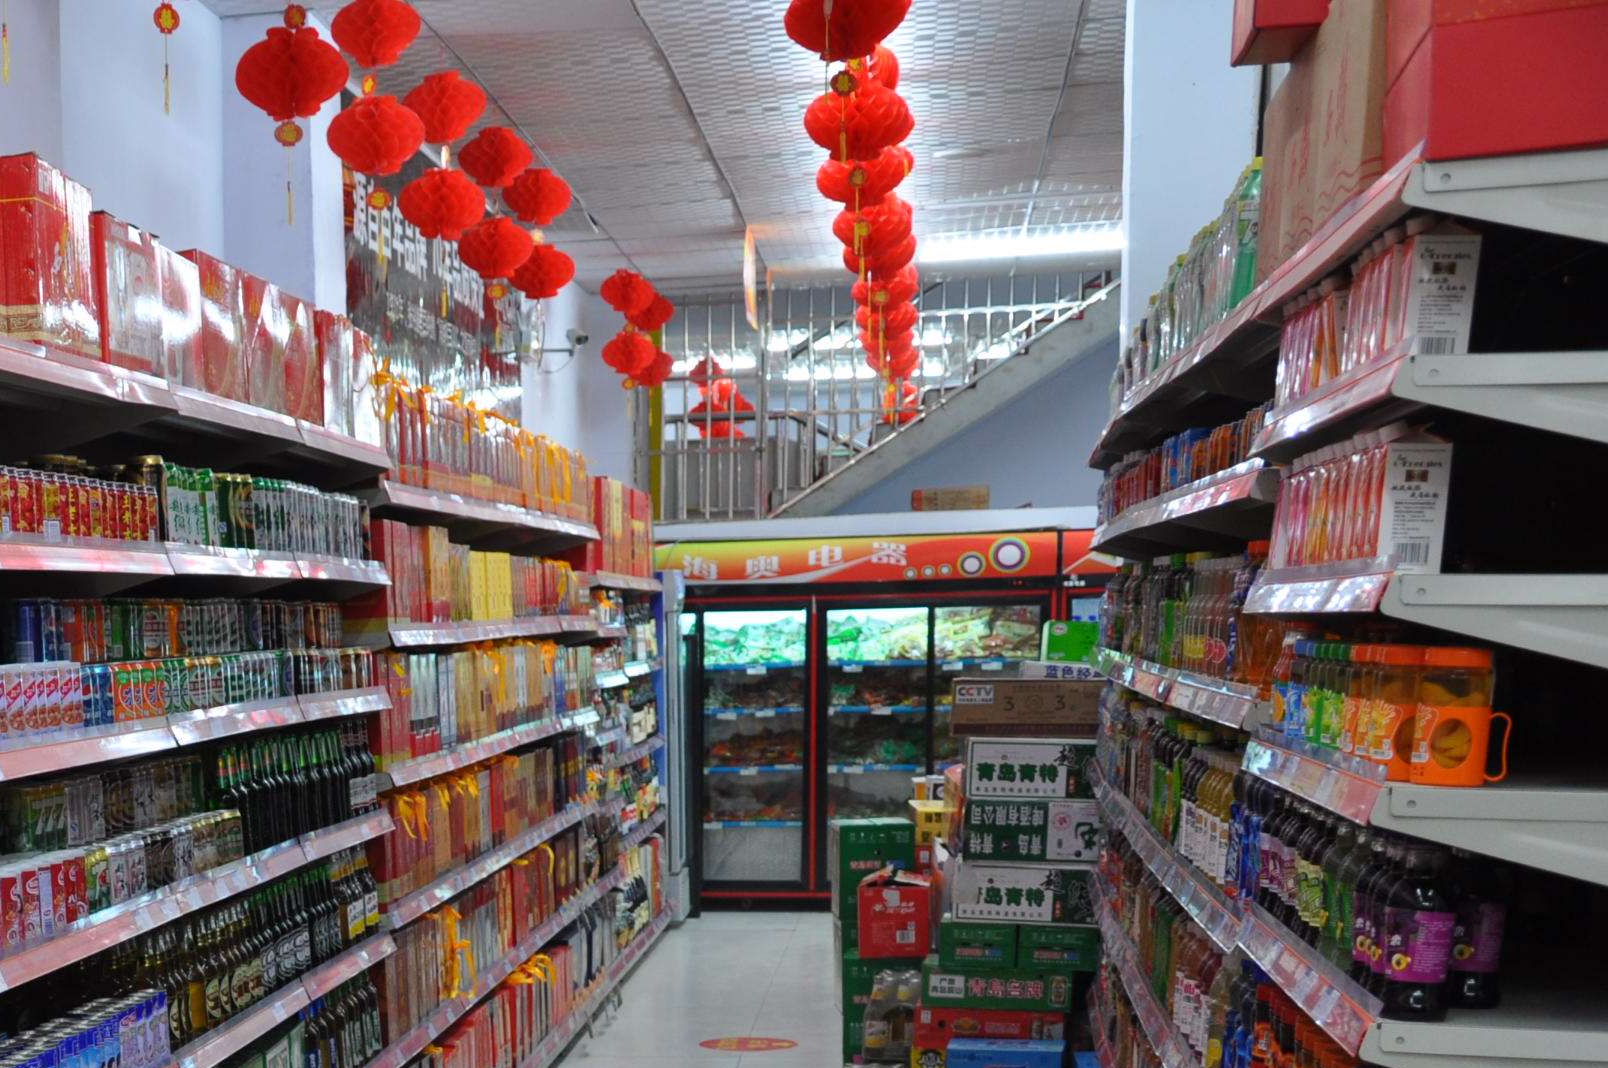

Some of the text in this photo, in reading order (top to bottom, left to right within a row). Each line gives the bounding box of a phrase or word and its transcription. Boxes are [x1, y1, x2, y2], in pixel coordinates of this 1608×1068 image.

[958, 686, 992, 698] CCTV
[976, 762, 1060, 784] 青岛青特
[976, 886, 1046, 908] 岛青特
